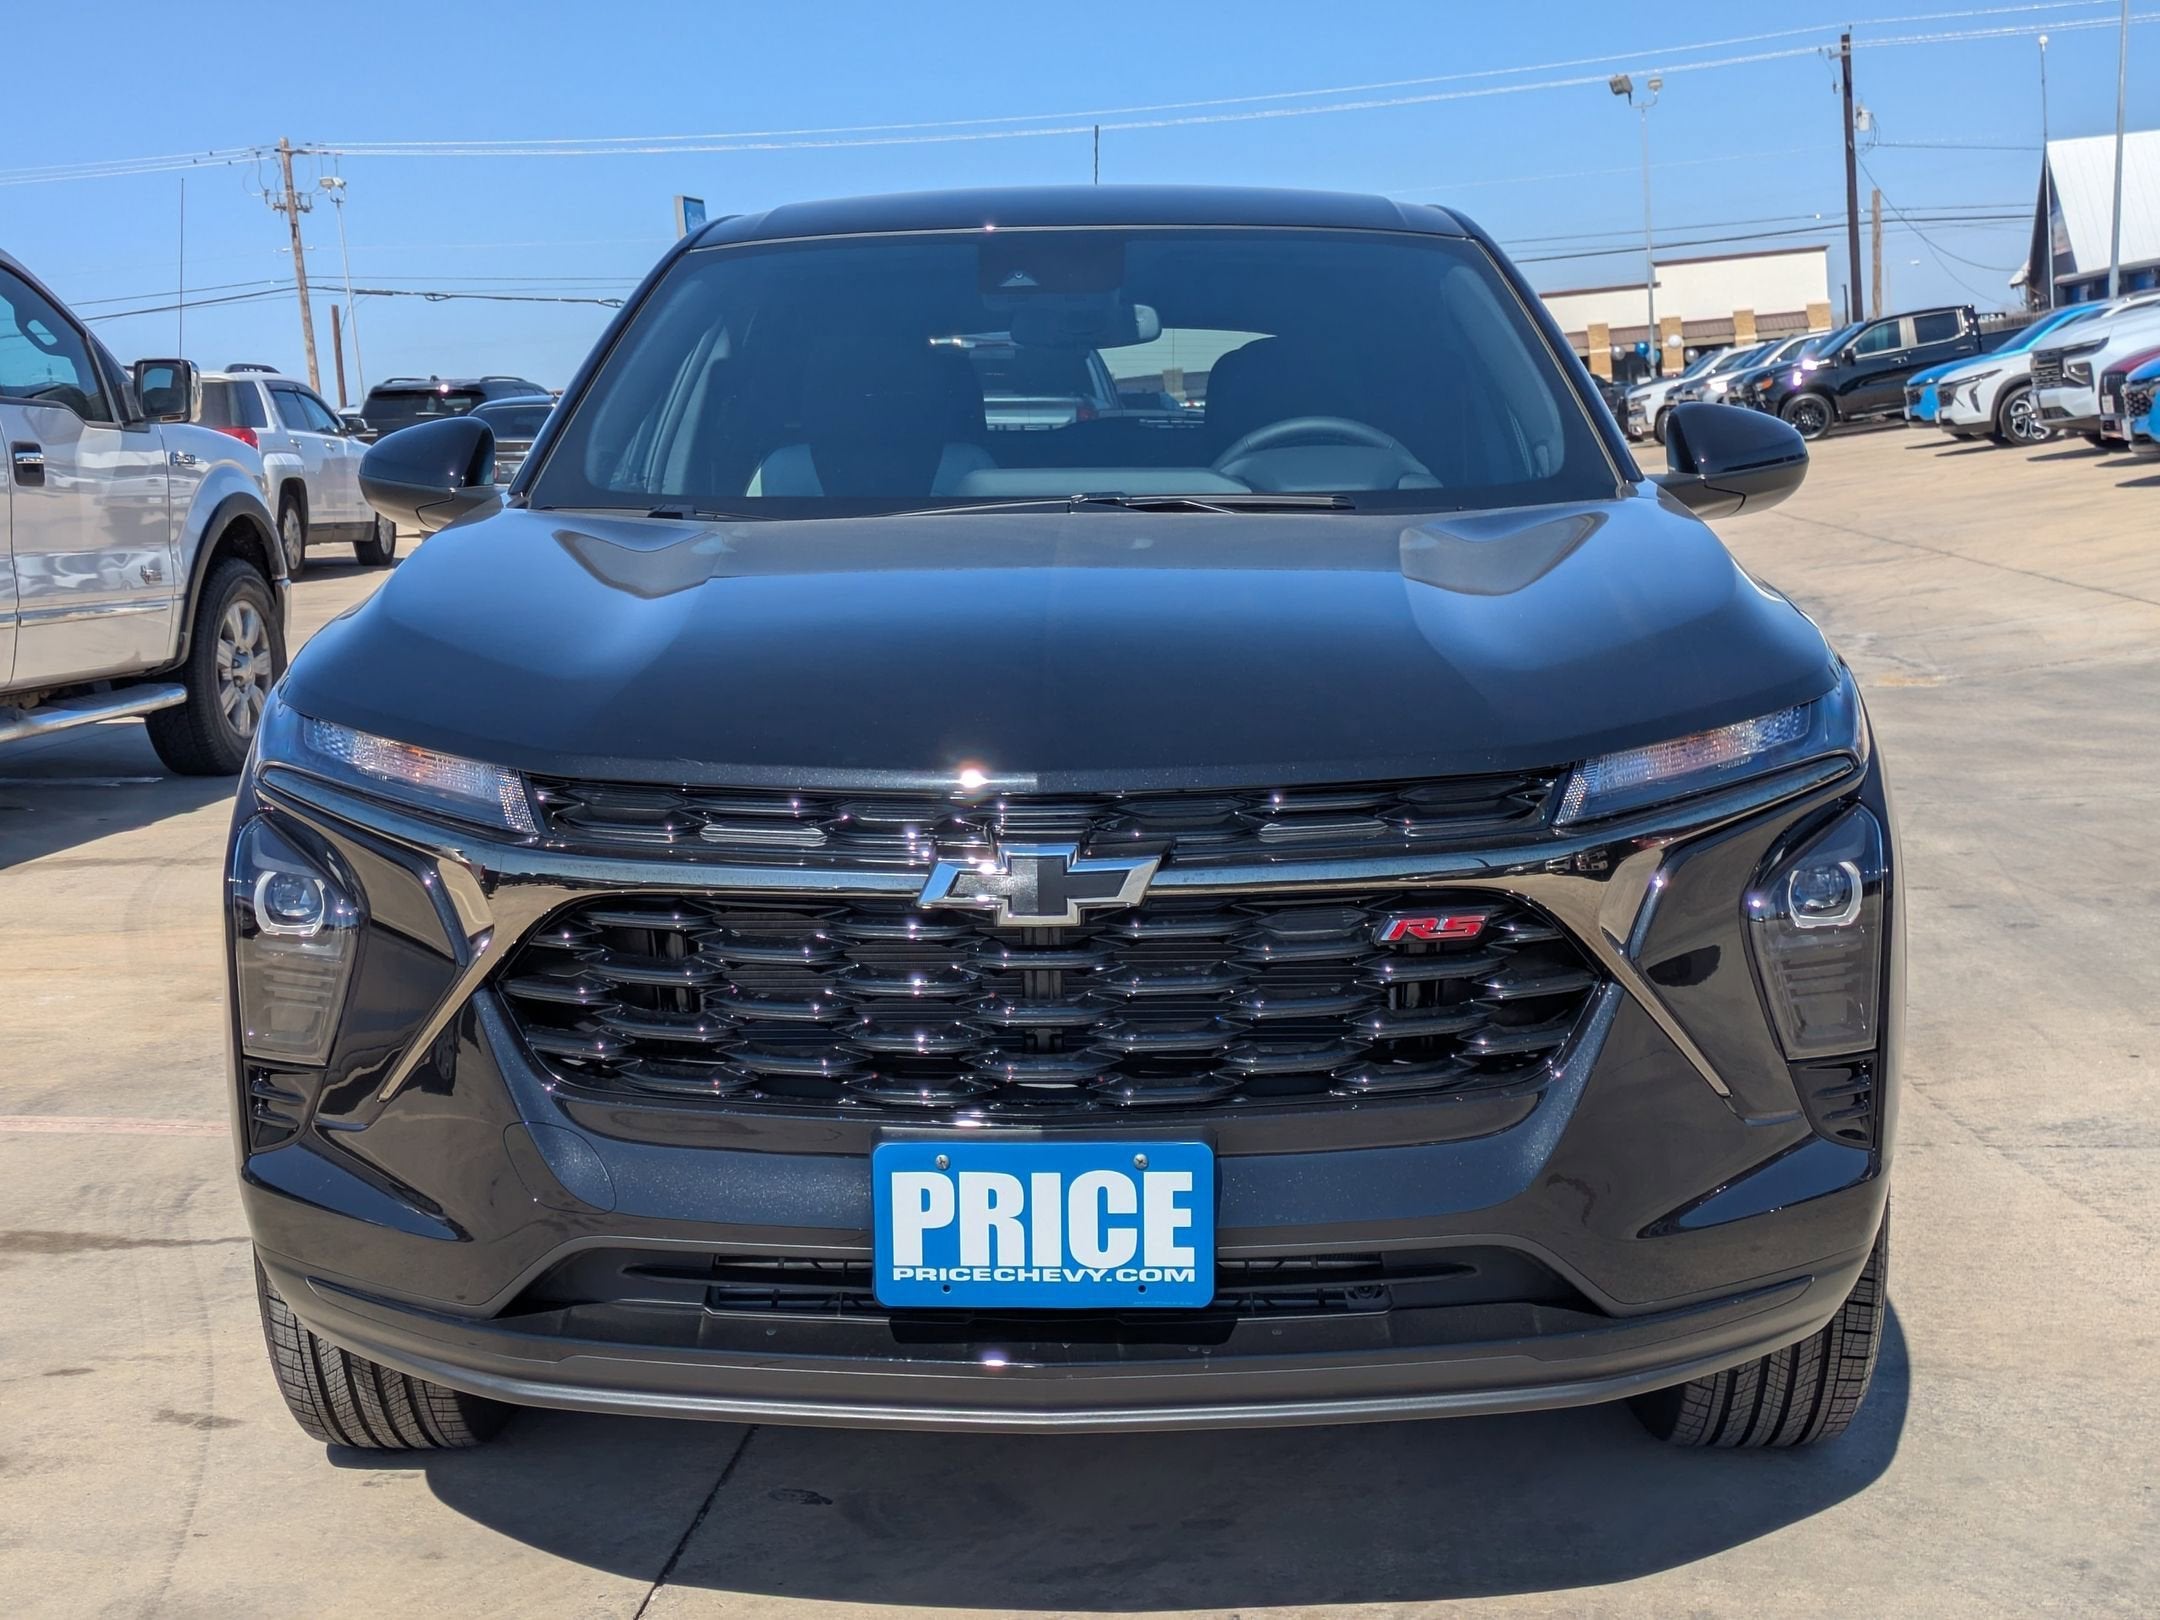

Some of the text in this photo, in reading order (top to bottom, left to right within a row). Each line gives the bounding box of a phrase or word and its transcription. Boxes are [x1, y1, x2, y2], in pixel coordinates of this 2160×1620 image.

[1380, 915, 1486, 940] RS
[891, 1170, 1196, 1268] PRICE
[892, 1267, 1196, 1282] PRICECHEVY.COM
